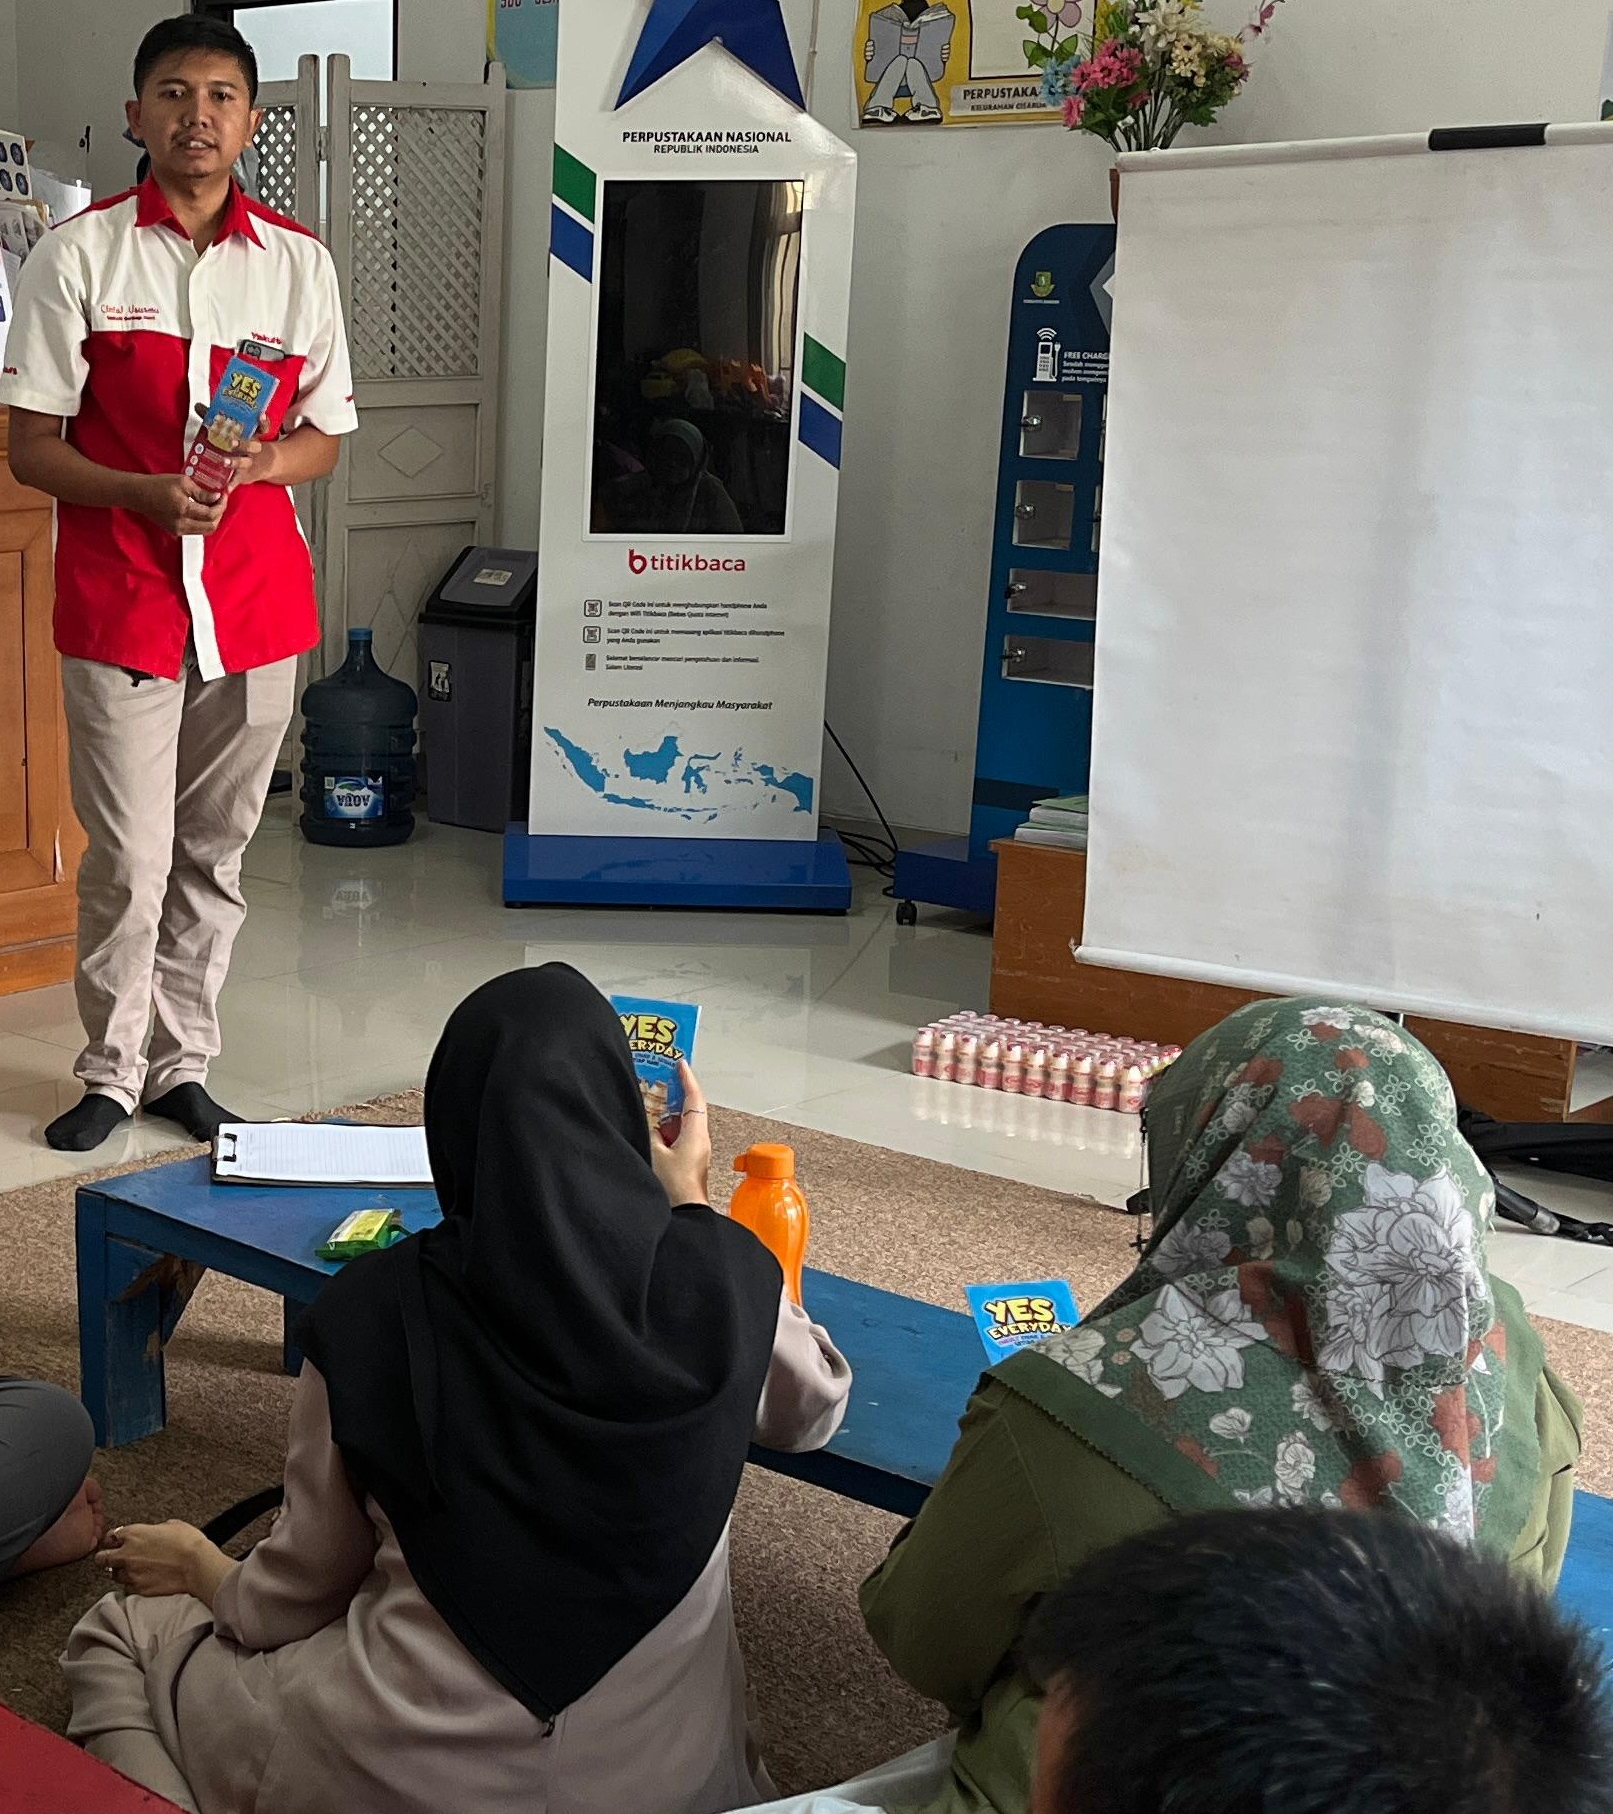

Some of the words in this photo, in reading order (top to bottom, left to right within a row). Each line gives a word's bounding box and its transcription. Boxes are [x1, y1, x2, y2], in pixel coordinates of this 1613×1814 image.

[963, 86, 1042, 100] PERPUSTAKA
[622, 131, 723, 142] PERPUSTAKAAN
[725, 131, 791, 142] NASIONAL
[654, 145, 702, 153] REPUBLIK
[705, 145, 759, 153] INDONESIA
[1064, 351, 1081, 359] FREE
[231, 371, 262, 398] YES
[650, 554, 745, 571] titikbaca
[587, 698, 653, 708] Perpustakaan
[655, 698, 714, 711] Menjangkau
[716, 699, 773, 711] Masyarakat
[619, 1013, 677, 1044] YES
[629, 1038, 684, 1060] ERYDAY
[984, 1297, 1055, 1325] YES
